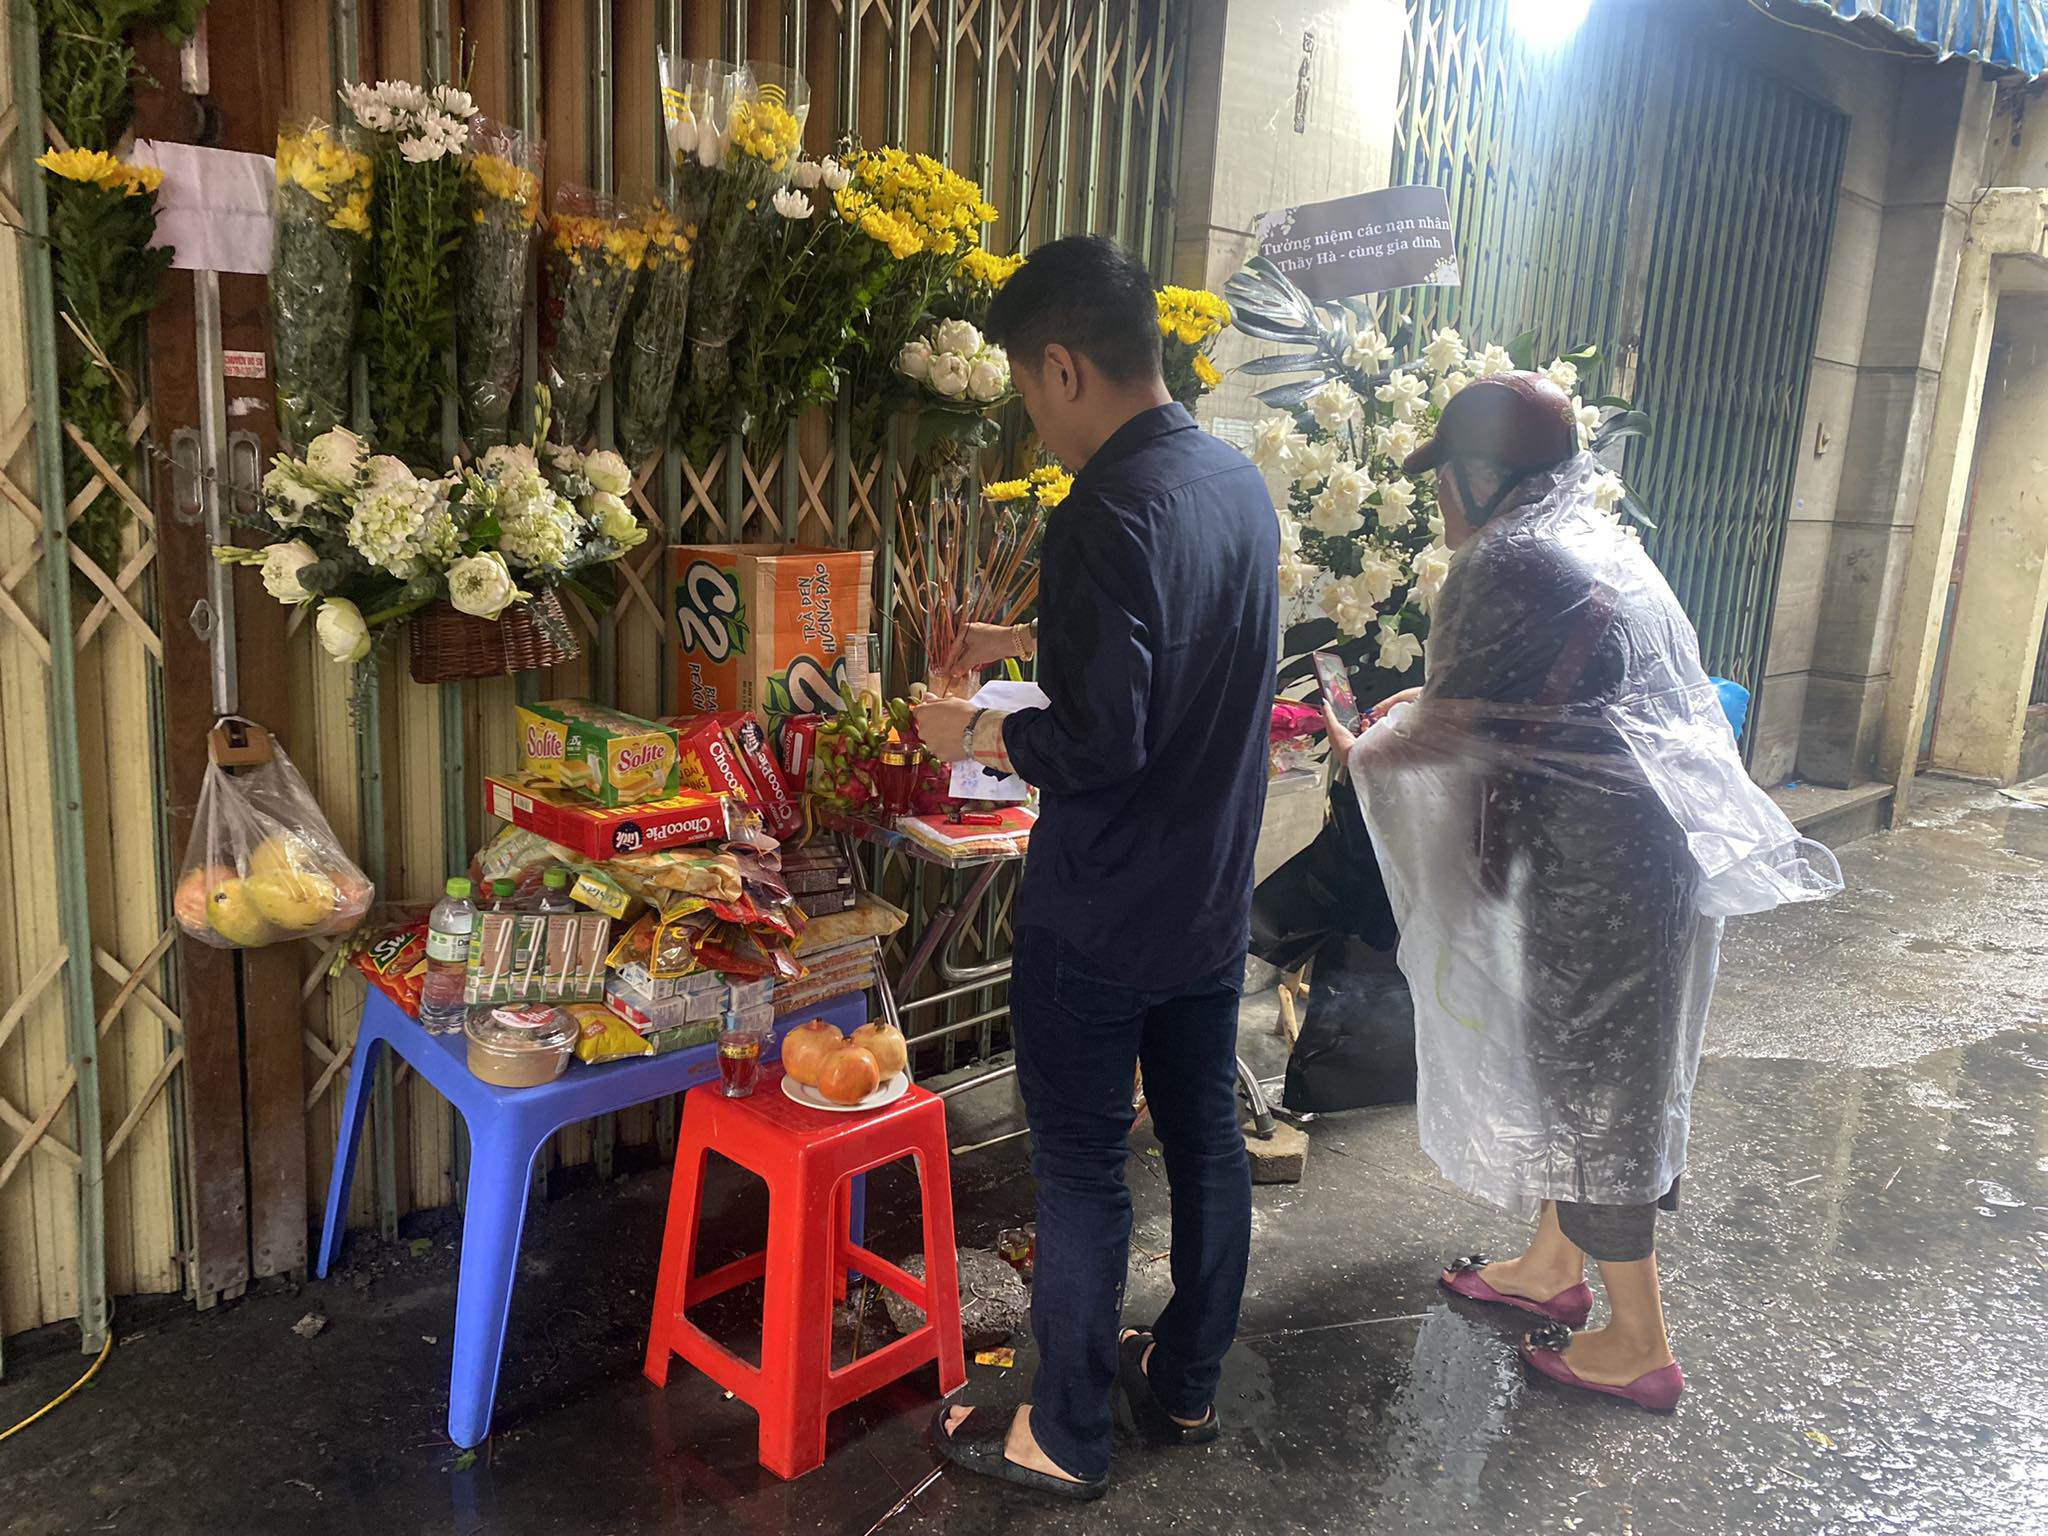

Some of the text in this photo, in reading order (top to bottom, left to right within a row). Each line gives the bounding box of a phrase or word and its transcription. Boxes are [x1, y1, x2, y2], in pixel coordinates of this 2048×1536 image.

[1262, 216, 1450, 256] Tưởng niệm các nạn nhân
[1278, 256, 1313, 273] Thầy
[1316, 251, 1337, 265] Hà
[1348, 244, 1384, 260] cùng
[1387, 239, 1409, 254] gia
[1412, 236, 1442, 249] đình
[678, 564, 736, 659] C2
[798, 577, 816, 643] TRÀ ĐEN
[688, 662, 704, 709] PEACH
[527, 726, 563, 757] Solite
[617, 745, 666, 771] Solite
[646, 816, 711, 841] ChocoPie
